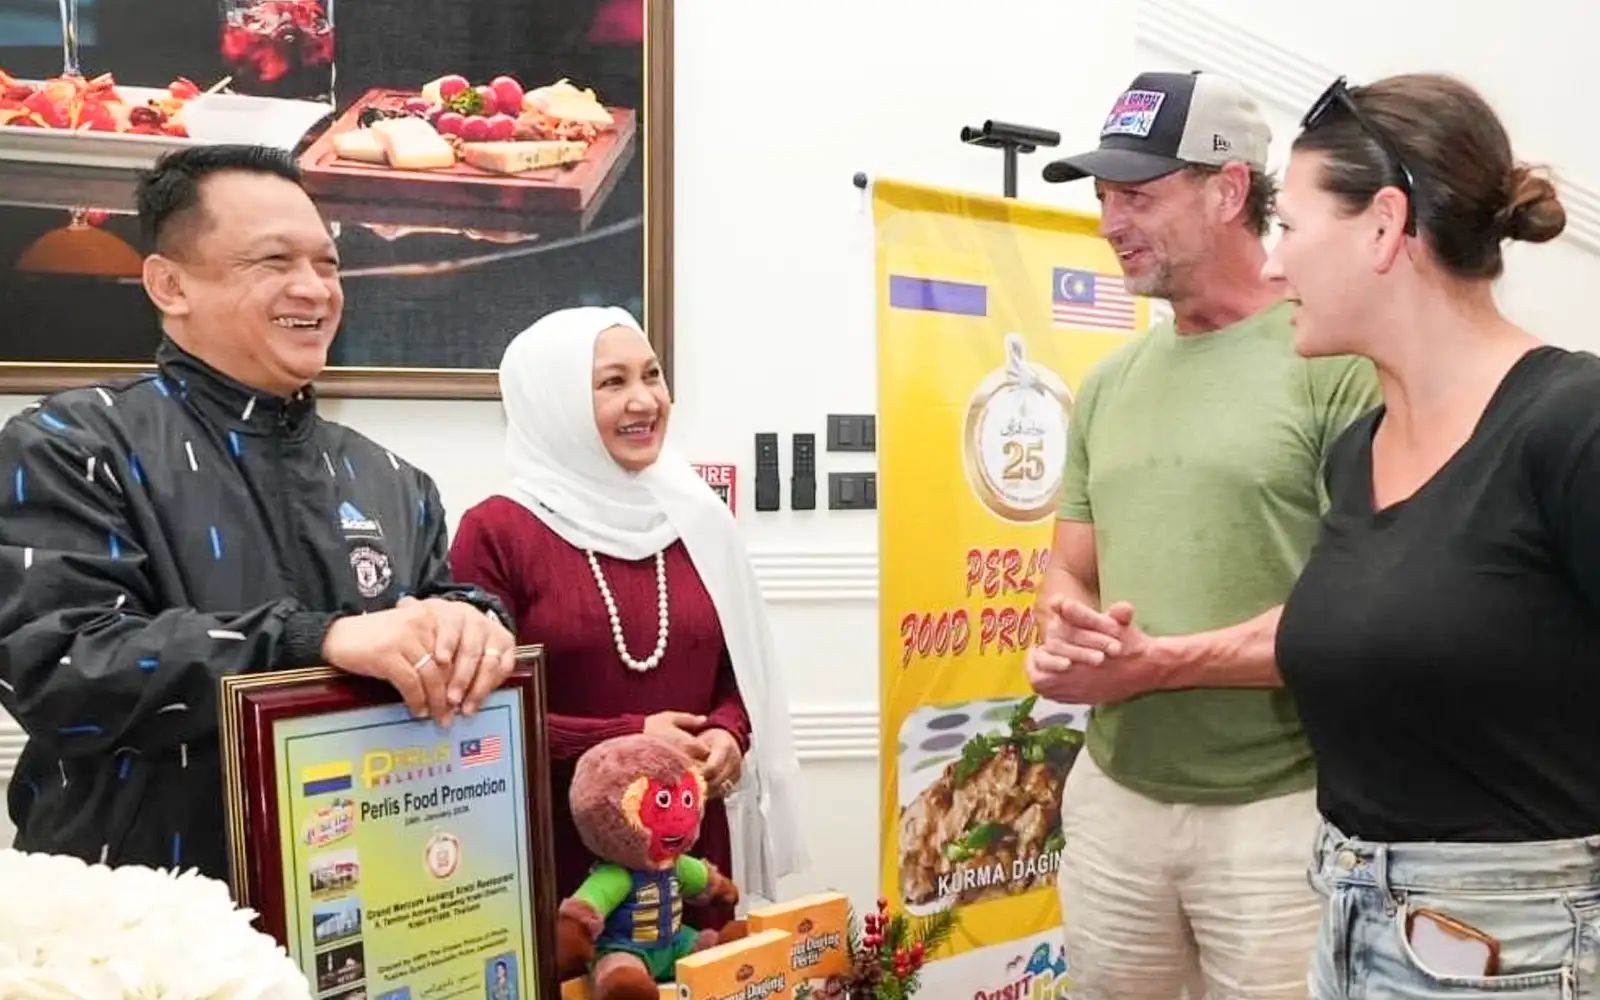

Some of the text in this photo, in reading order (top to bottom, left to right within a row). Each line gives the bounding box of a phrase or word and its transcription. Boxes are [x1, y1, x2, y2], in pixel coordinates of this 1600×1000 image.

[1002, 440, 1046, 481] 25
[360, 799, 400, 822] Perlis
[403, 787, 438, 813] Food
[441, 776, 506, 804] Promotion
[938, 865, 1005, 896] KURMA
